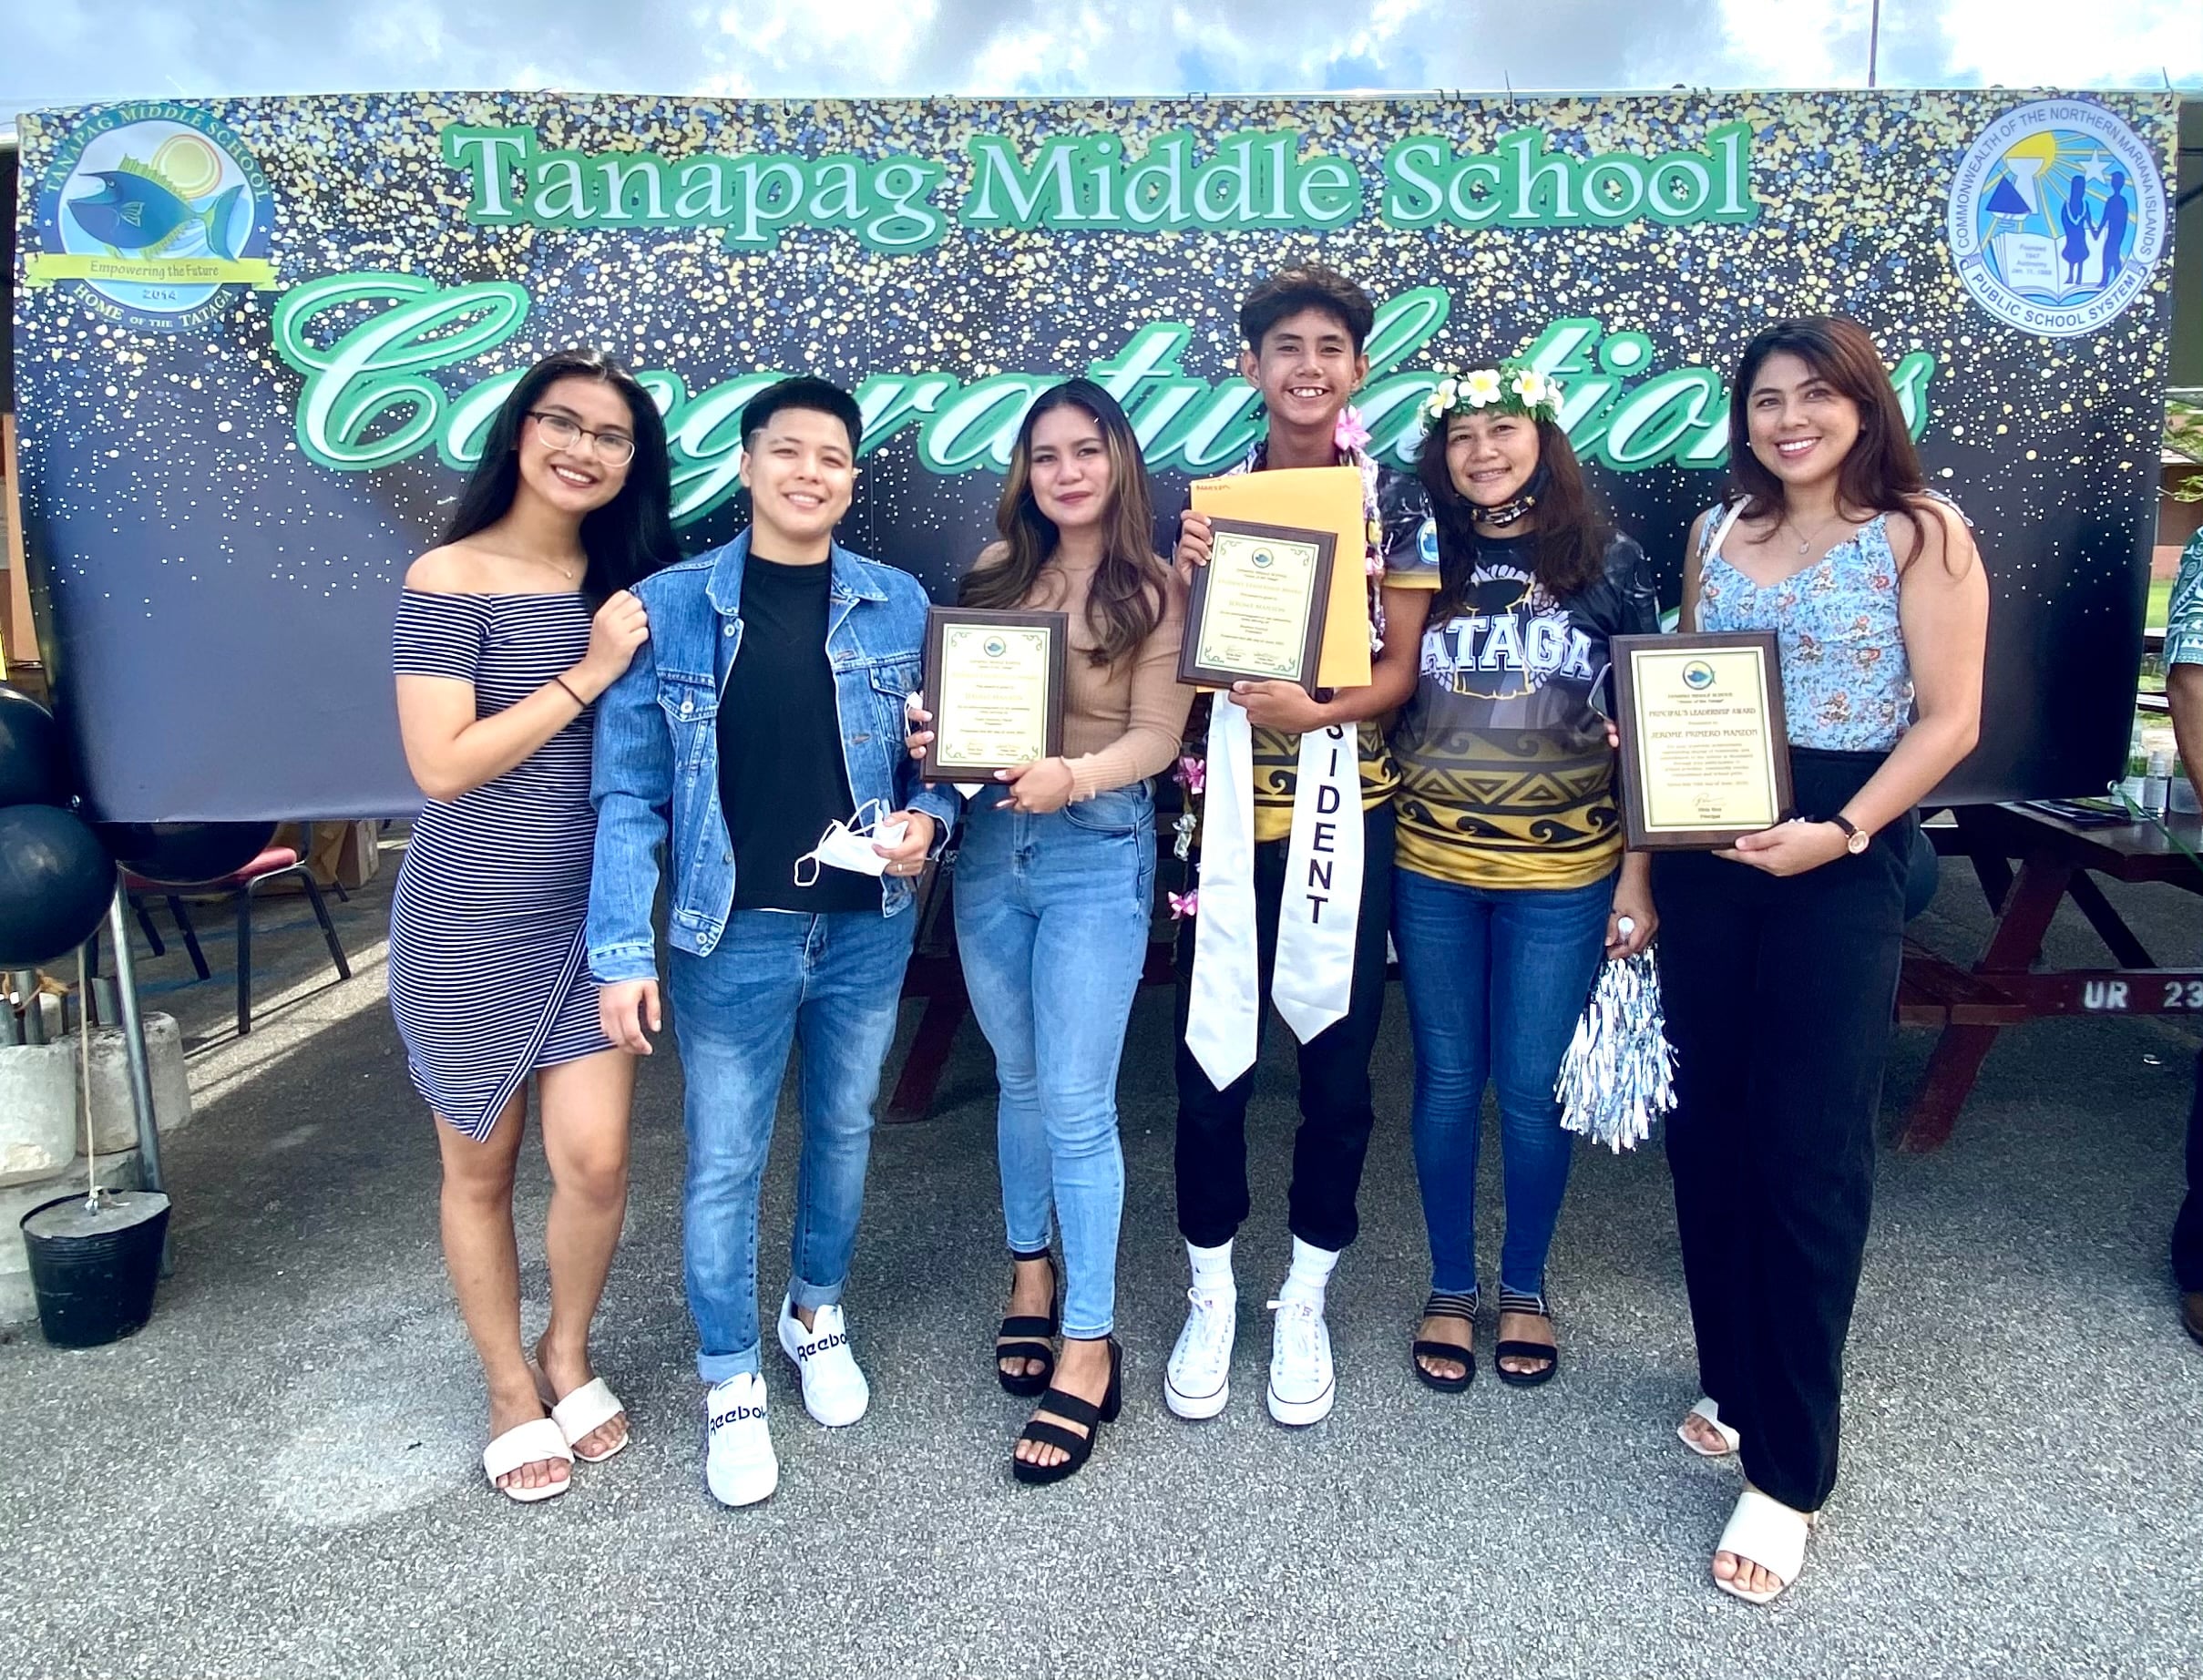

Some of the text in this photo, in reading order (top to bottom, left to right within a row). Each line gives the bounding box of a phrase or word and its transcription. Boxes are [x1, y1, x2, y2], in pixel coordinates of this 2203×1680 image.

[46, 105, 270, 203] TANAPAG MIDDLE SCHOOL
[452, 128, 1749, 247] Tanapag Middle School
[1955, 107, 2158, 257] COMMONWEALTH OF THE NORTHERN MARIANA ISLANDS
[90, 260, 220, 281] Empowering the Future
[73, 283, 233, 329] HOME OF THE TATAGA
[1972, 273, 2136, 328] PUBLIC SCHOOL SYSTEM
[1649, 707, 1757, 718] PRINCIPAL'S LEADERSHIP AWARD
[1650, 731, 1683, 739] JEROME
[1685, 730, 1721, 738] PRIMERO
[2084, 980, 2127, 1009] UR
